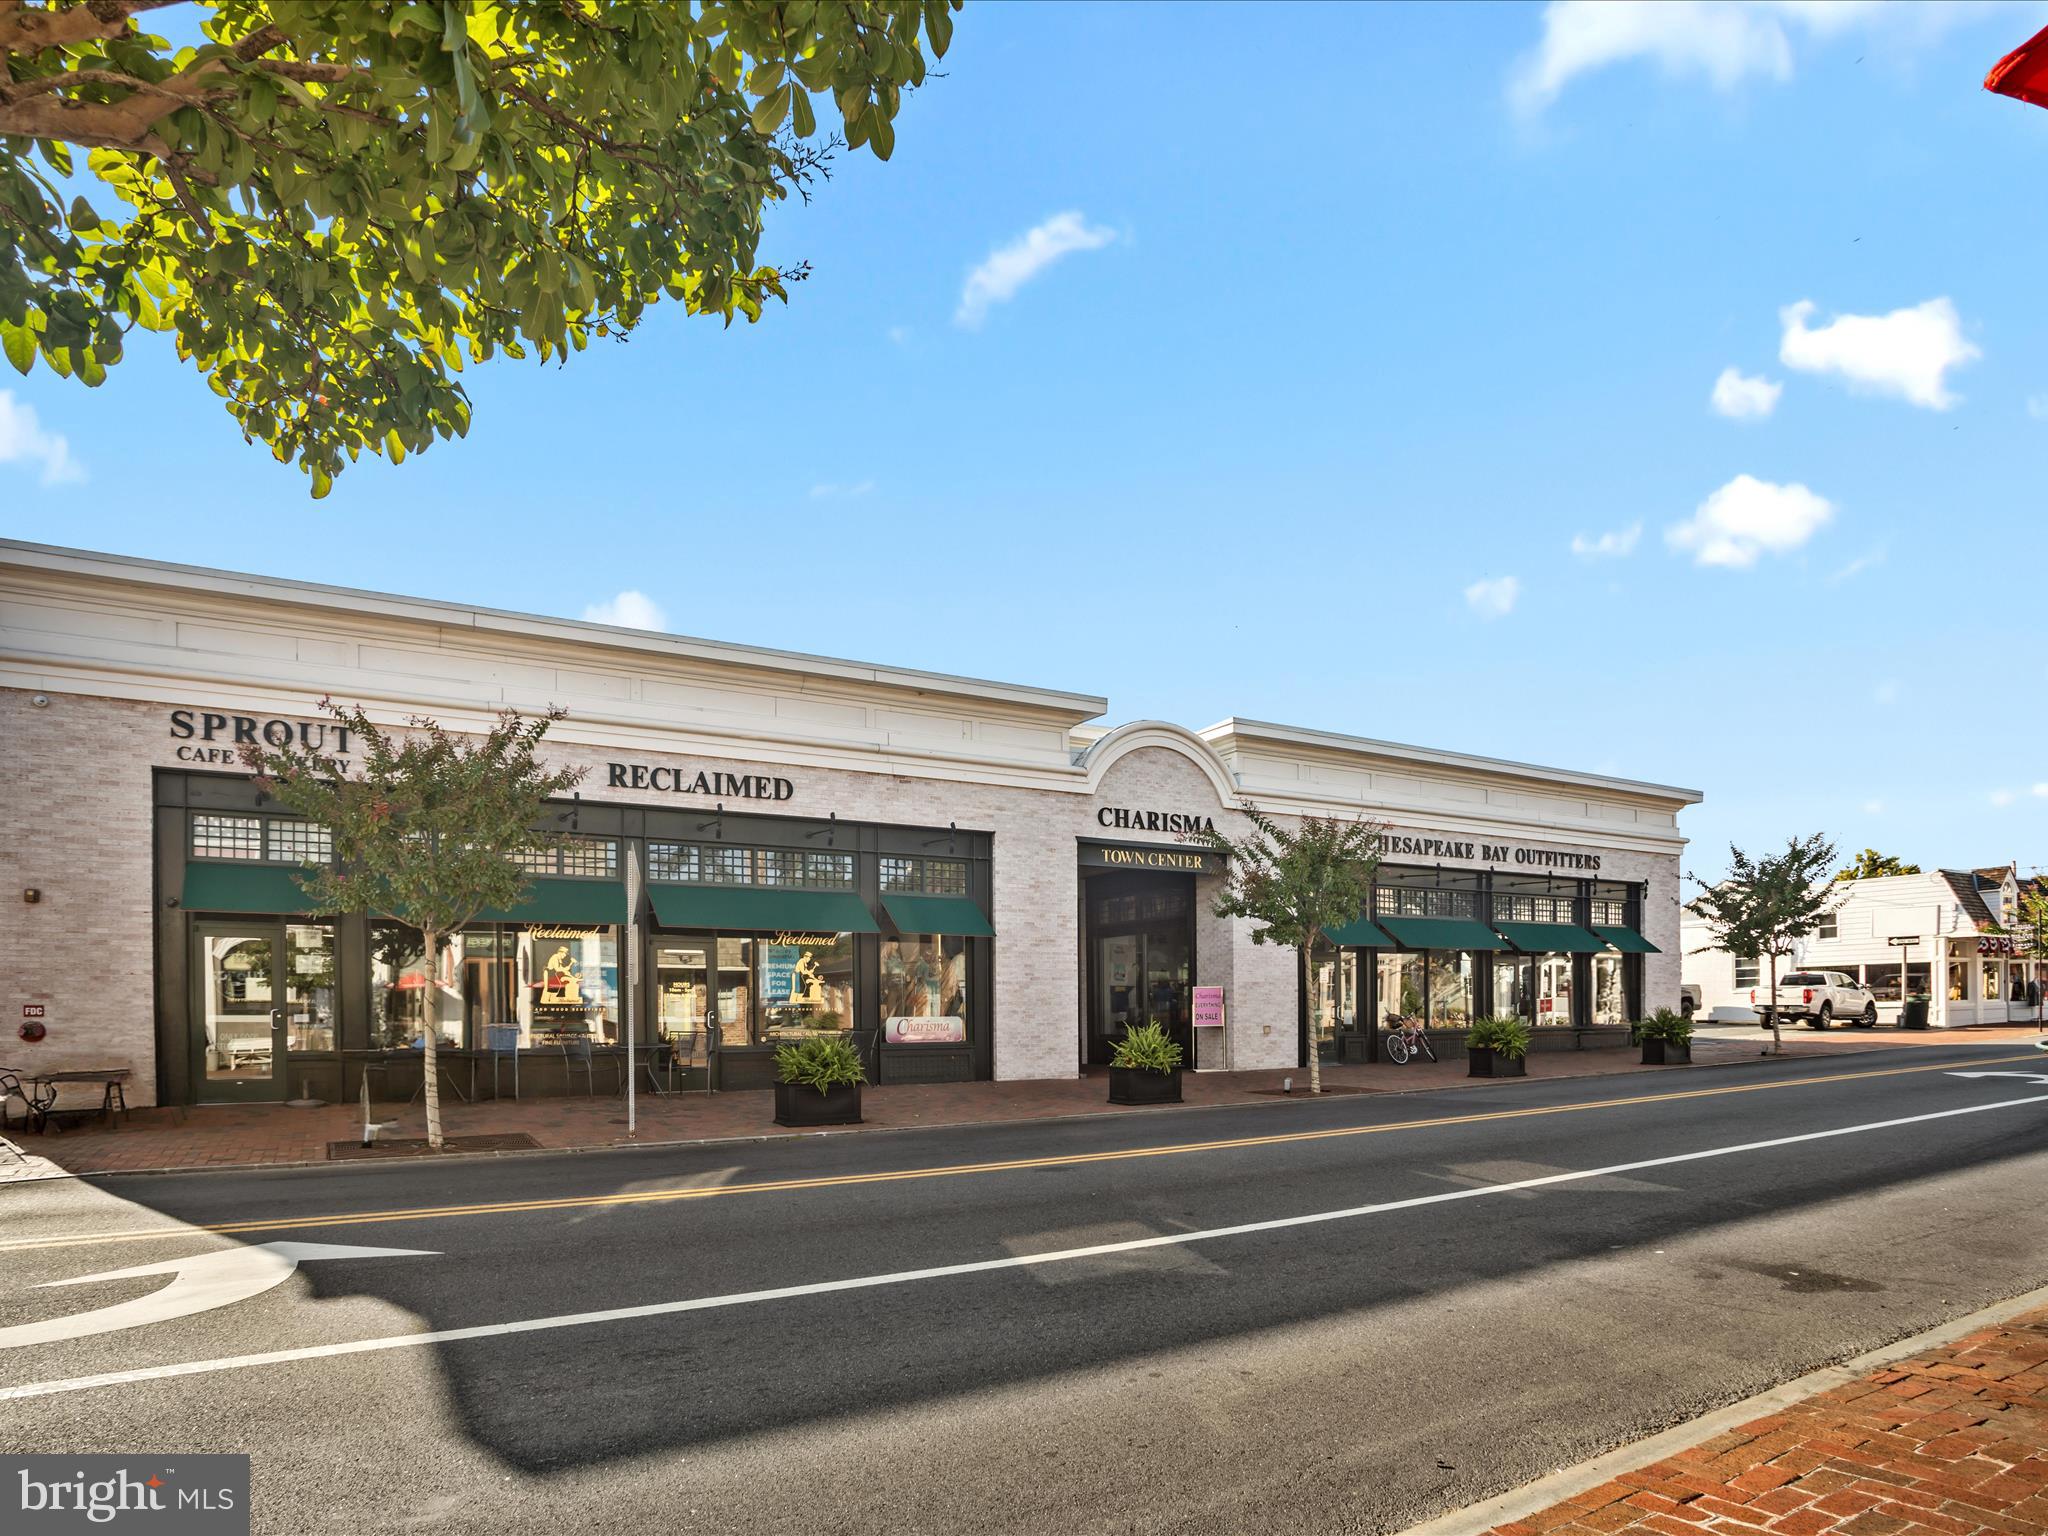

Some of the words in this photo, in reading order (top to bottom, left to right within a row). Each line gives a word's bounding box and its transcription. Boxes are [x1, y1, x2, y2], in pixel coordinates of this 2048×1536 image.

[170, 710, 350, 754] SPROUT
[177, 746, 235, 765] CAFE
[606, 762, 794, 801] RECLAIMED
[1097, 807, 1216, 834] CHARISMA
[1101, 849, 1145, 865] TOWN
[1148, 852, 1203, 869] CENTER
[1481, 844, 1510, 863] BAY
[1515, 848, 1601, 870] OUTFITTERS
[523, 922, 600, 941] Reclaimed
[770, 930, 839, 947] Reclaimed
[25, 1007, 43, 1015] FDC
[1195, 1013, 1204, 1021] ON
[896, 1019, 951, 1036] Charisma
